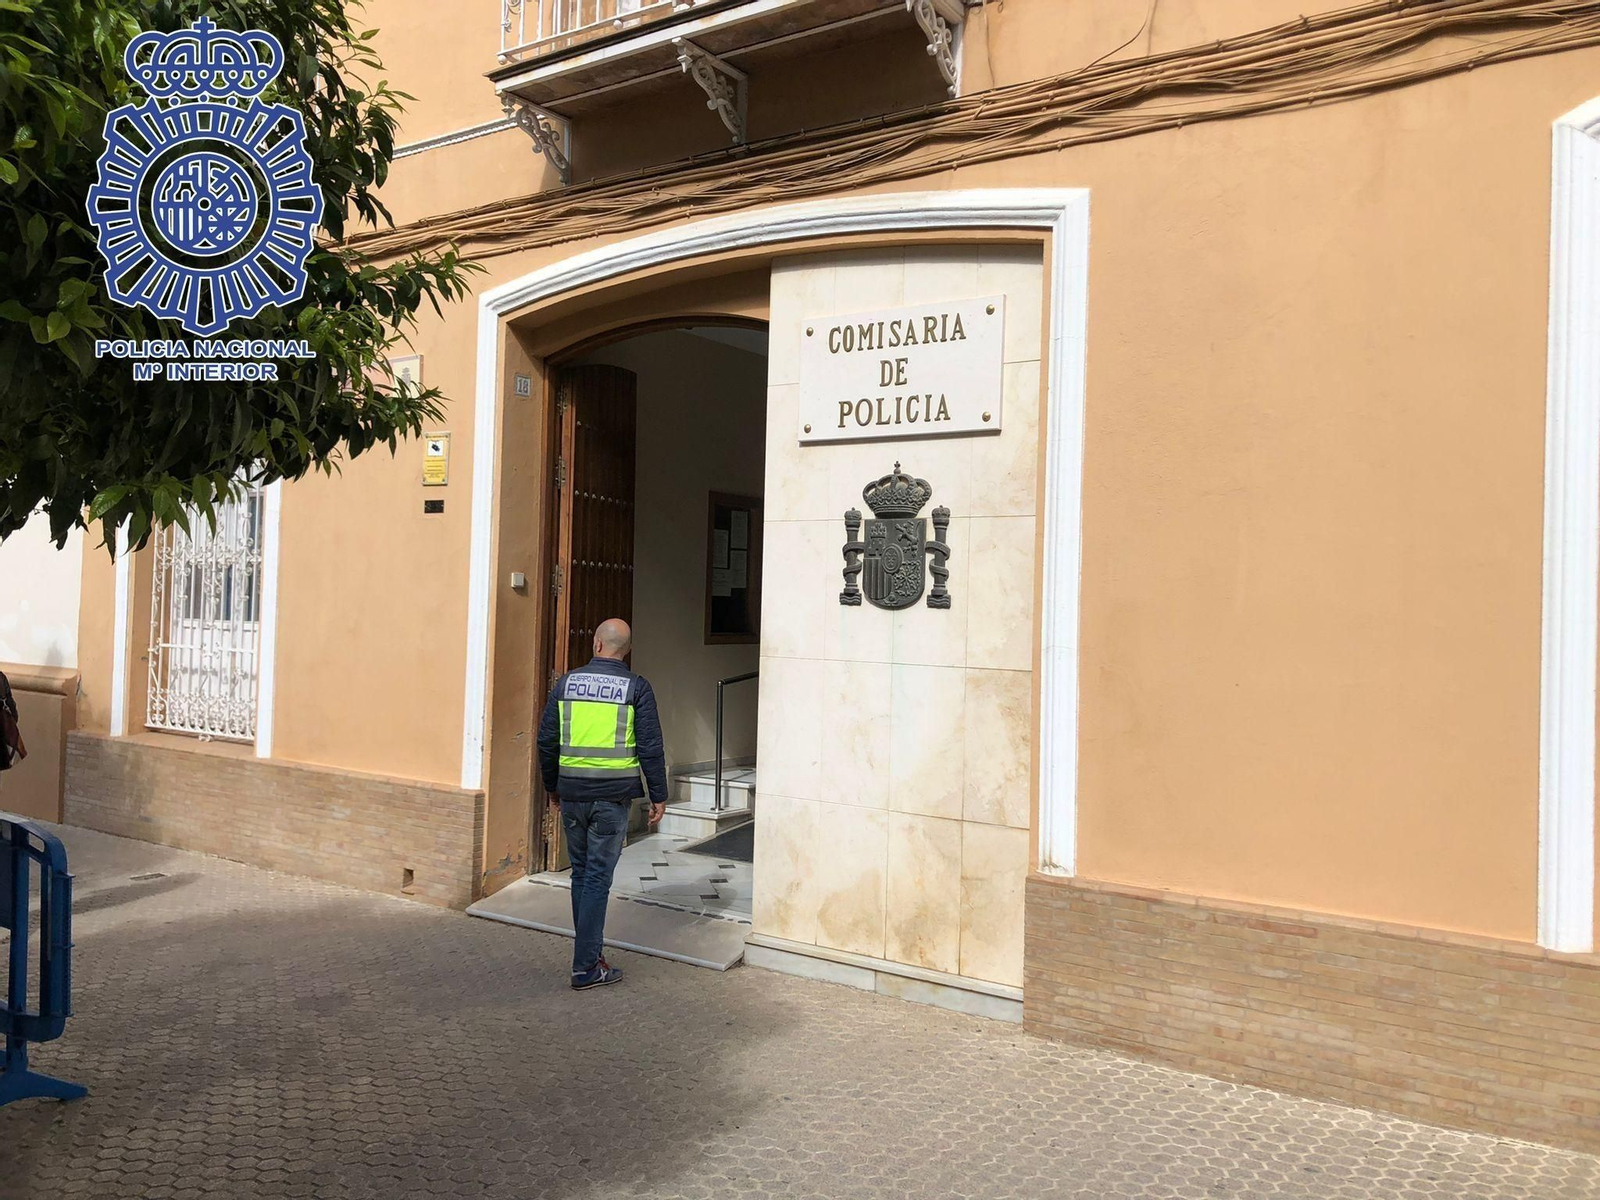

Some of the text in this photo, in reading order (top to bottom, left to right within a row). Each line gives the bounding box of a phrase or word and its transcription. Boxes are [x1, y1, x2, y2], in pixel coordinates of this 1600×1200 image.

[828, 312, 967, 354] COMISARIA
[879, 357, 909, 387] DE
[837, 393, 951, 428] POLICIA
[566, 683, 623, 700] POLICIA
[592, 676, 617, 685] NACIONAL
